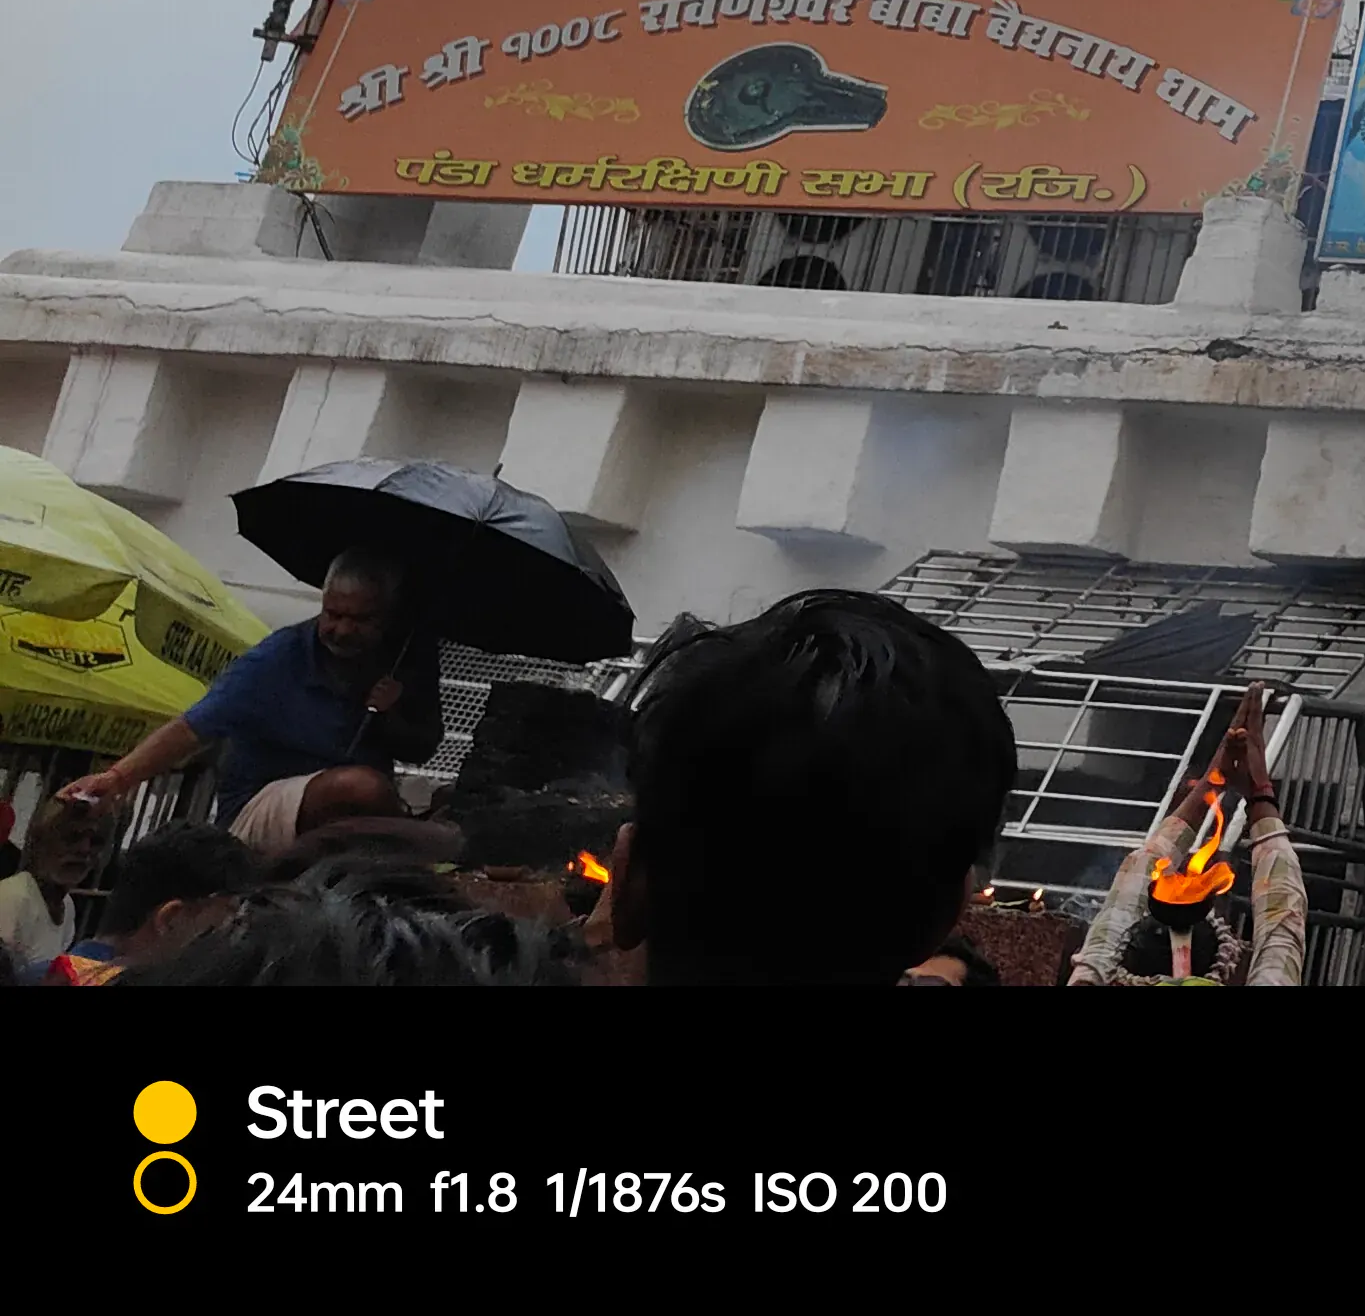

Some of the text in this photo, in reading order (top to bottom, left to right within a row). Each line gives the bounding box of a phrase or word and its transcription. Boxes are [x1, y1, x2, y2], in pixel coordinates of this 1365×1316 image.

[338, 64, 411, 121] श्री
[420, 36, 491, 89] श्री
[502, 11, 626, 63] १००८
[1156, 68, 1259, 144] धाम
[395, 150, 1148, 210] पंडा धर्मरक्षिणी सभा (रजि.)
